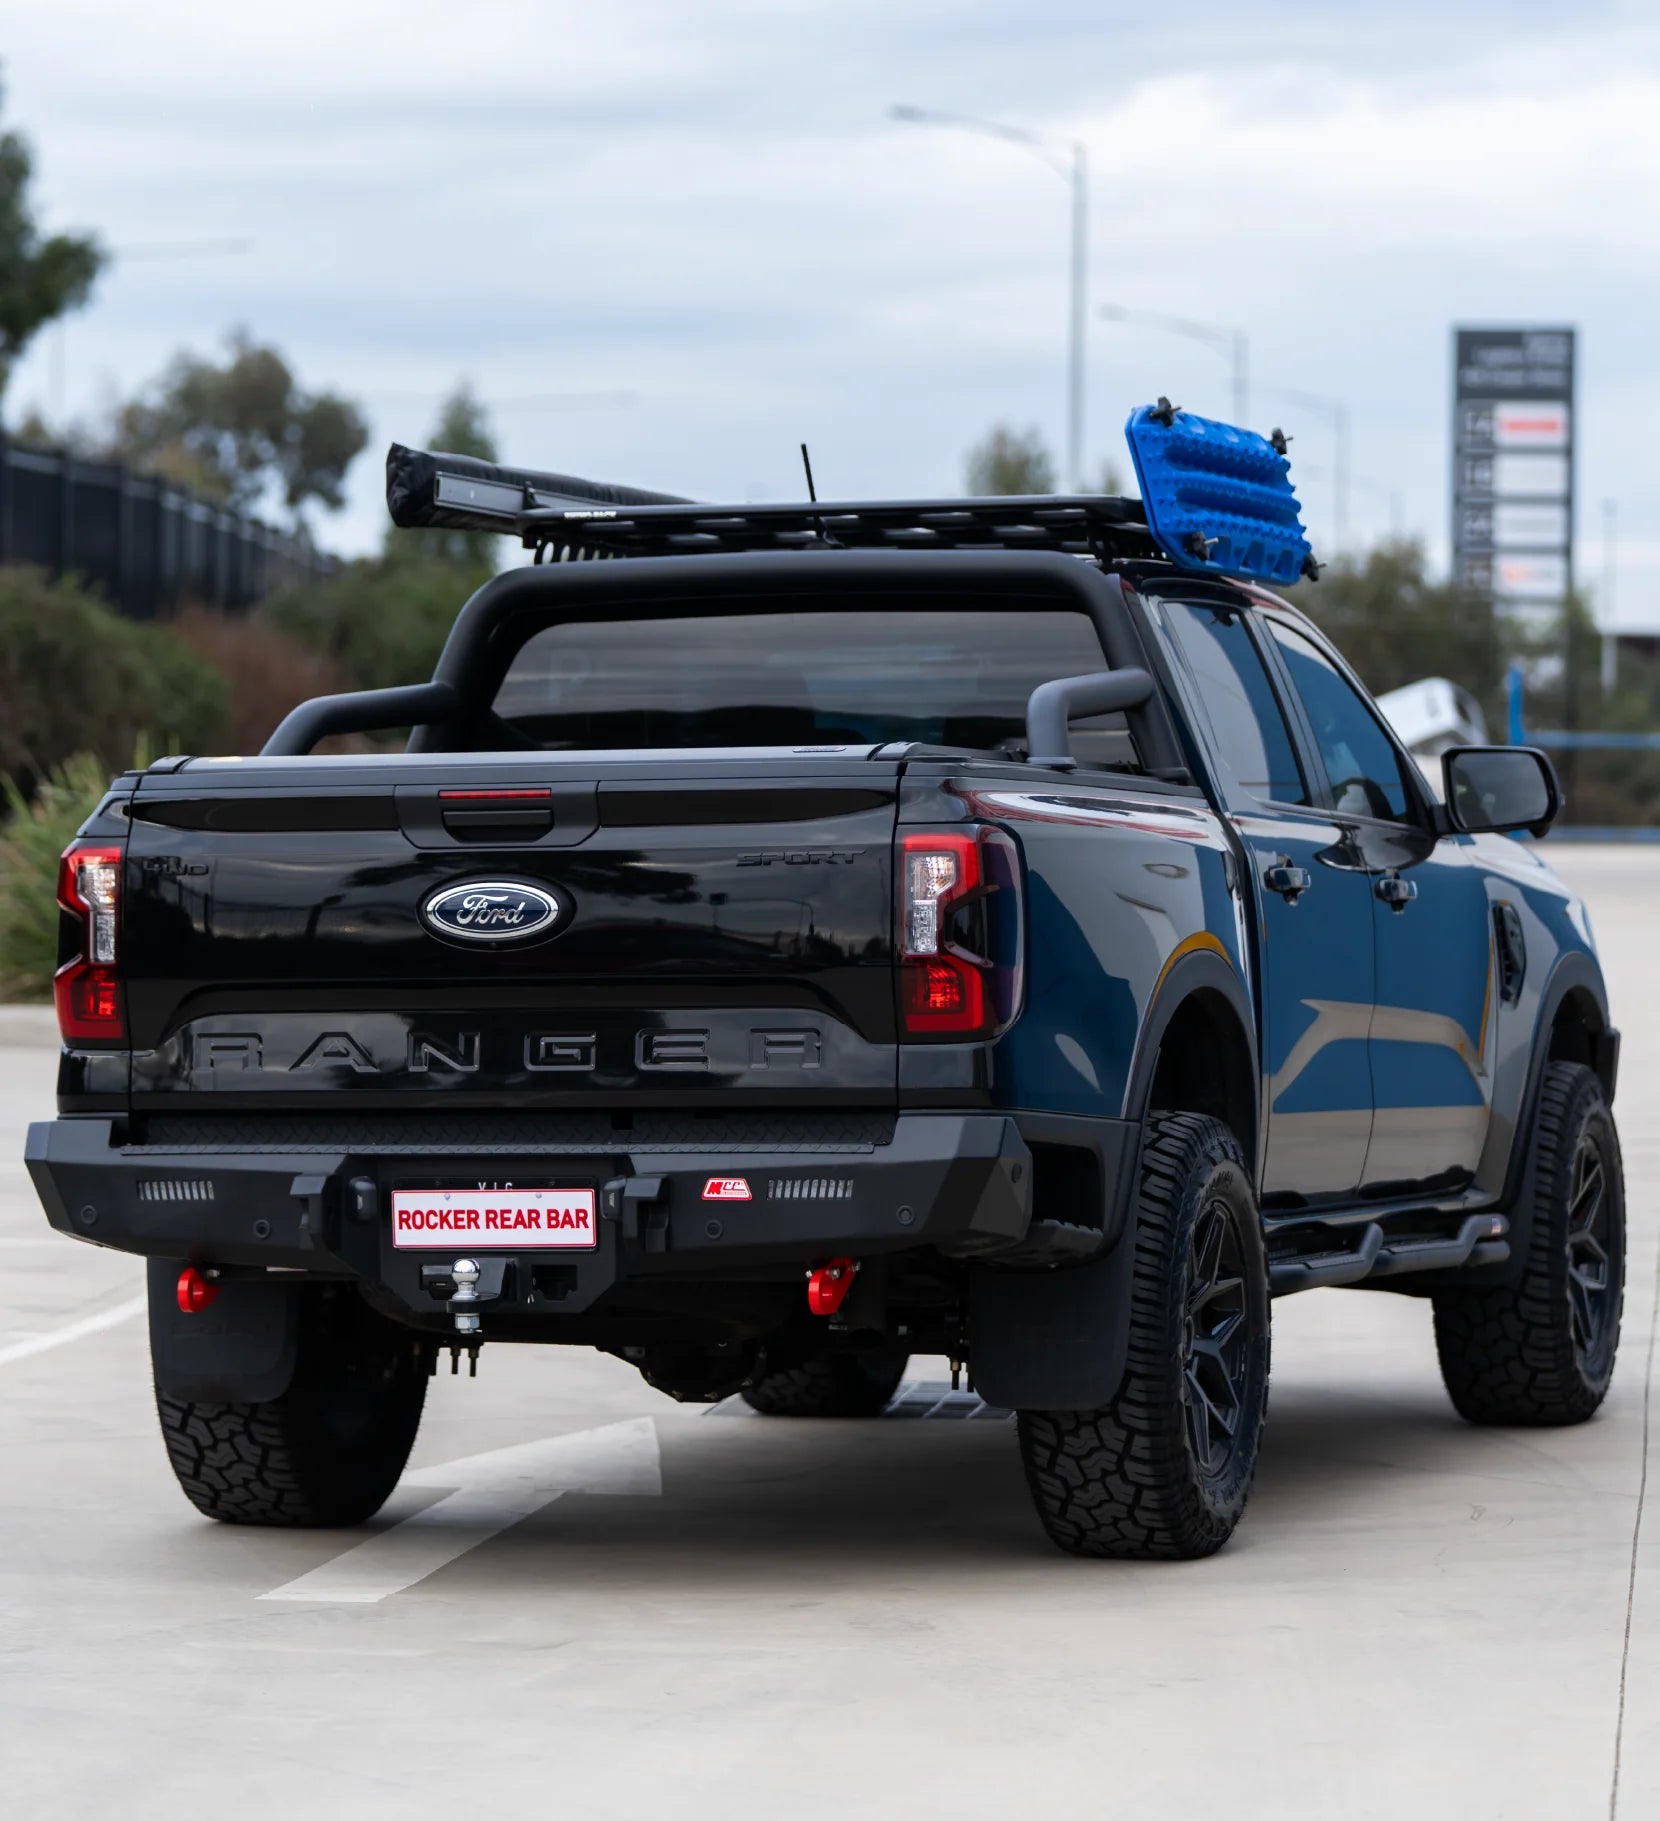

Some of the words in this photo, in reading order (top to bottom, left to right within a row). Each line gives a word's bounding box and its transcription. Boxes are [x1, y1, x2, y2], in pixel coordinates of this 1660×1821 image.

[142, 858, 209, 876] 4WD
[736, 850, 867, 867] SPORT
[456, 894, 526, 925] Ford
[193, 1028, 822, 1072] RANGER
[478, 1182, 513, 1191] VIC
[706, 1181, 746, 1195] MCC
[398, 1209, 480, 1230] ROCKER
[485, 1208, 541, 1230] REAR
[546, 1208, 589, 1229] BAR
